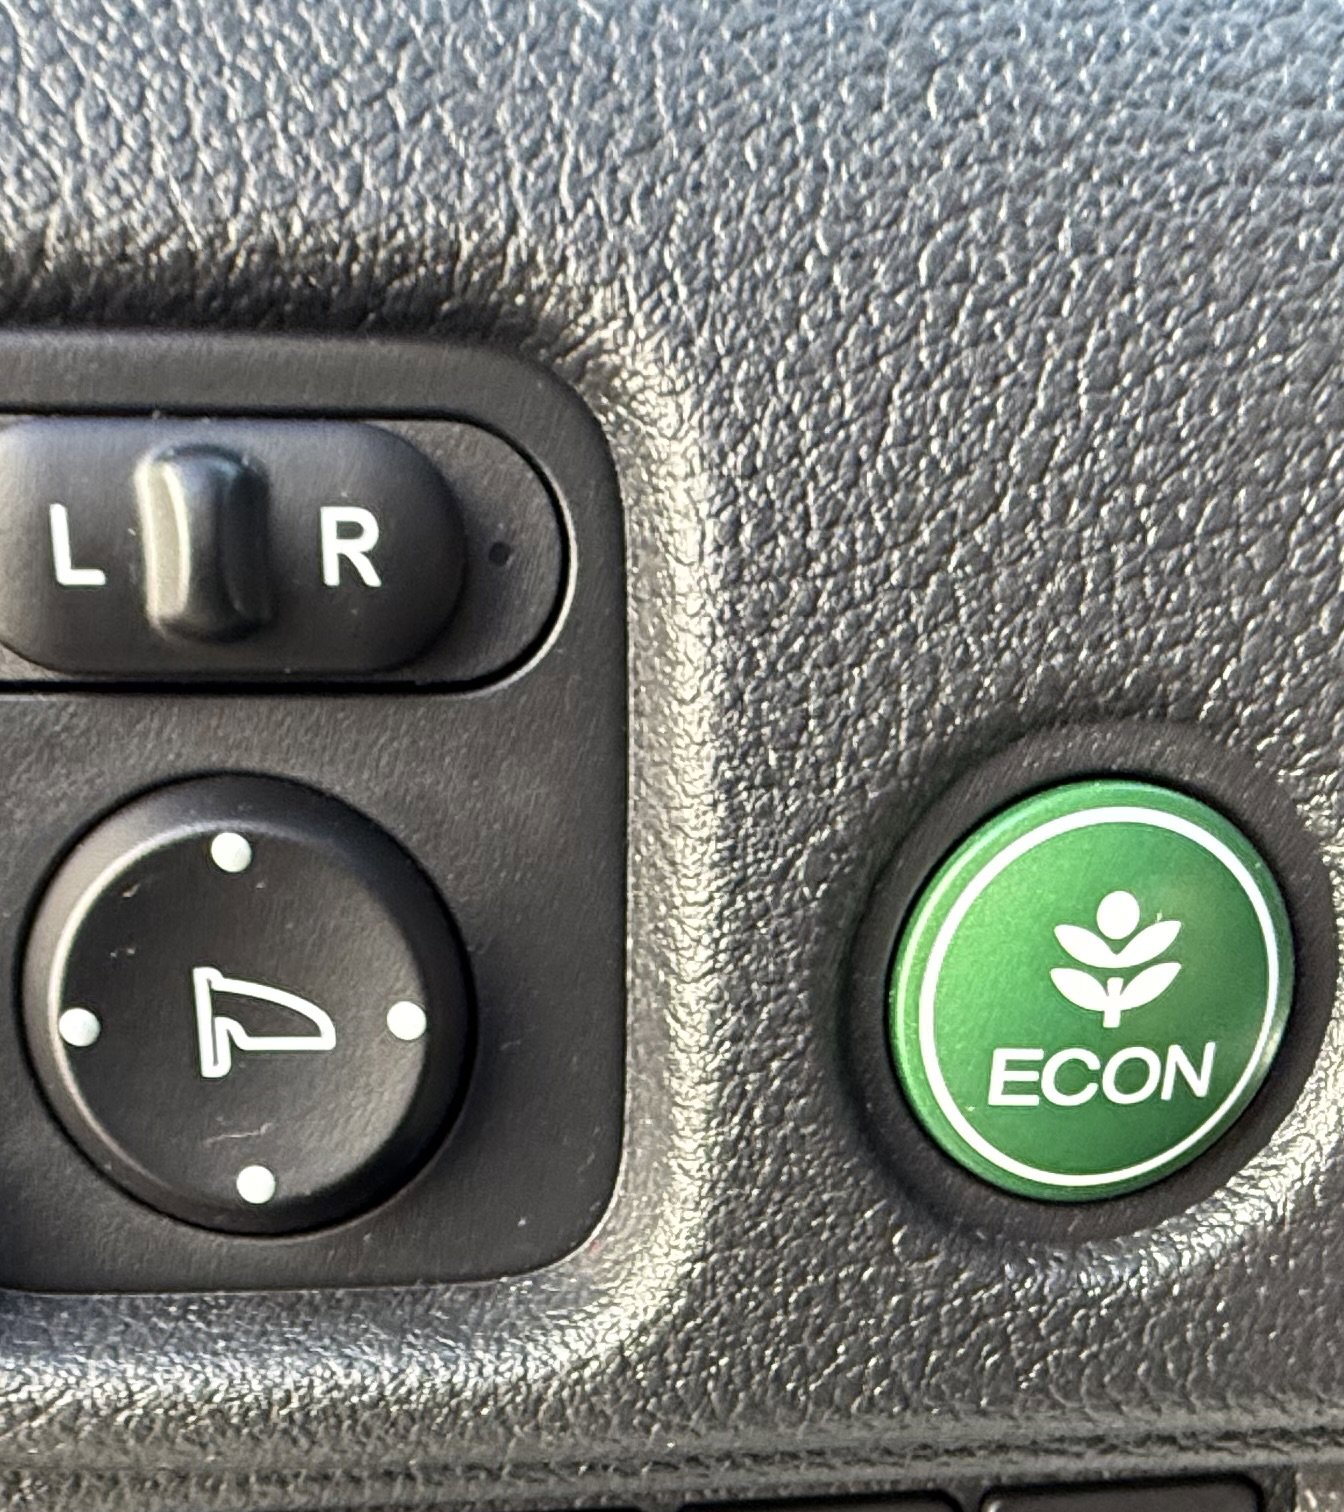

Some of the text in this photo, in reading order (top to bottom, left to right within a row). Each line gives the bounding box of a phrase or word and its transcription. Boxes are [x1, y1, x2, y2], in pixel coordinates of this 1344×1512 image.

[49, 503, 106, 586] L
[320, 506, 382, 588] R
[987, 1041, 1216, 1107] ECON
